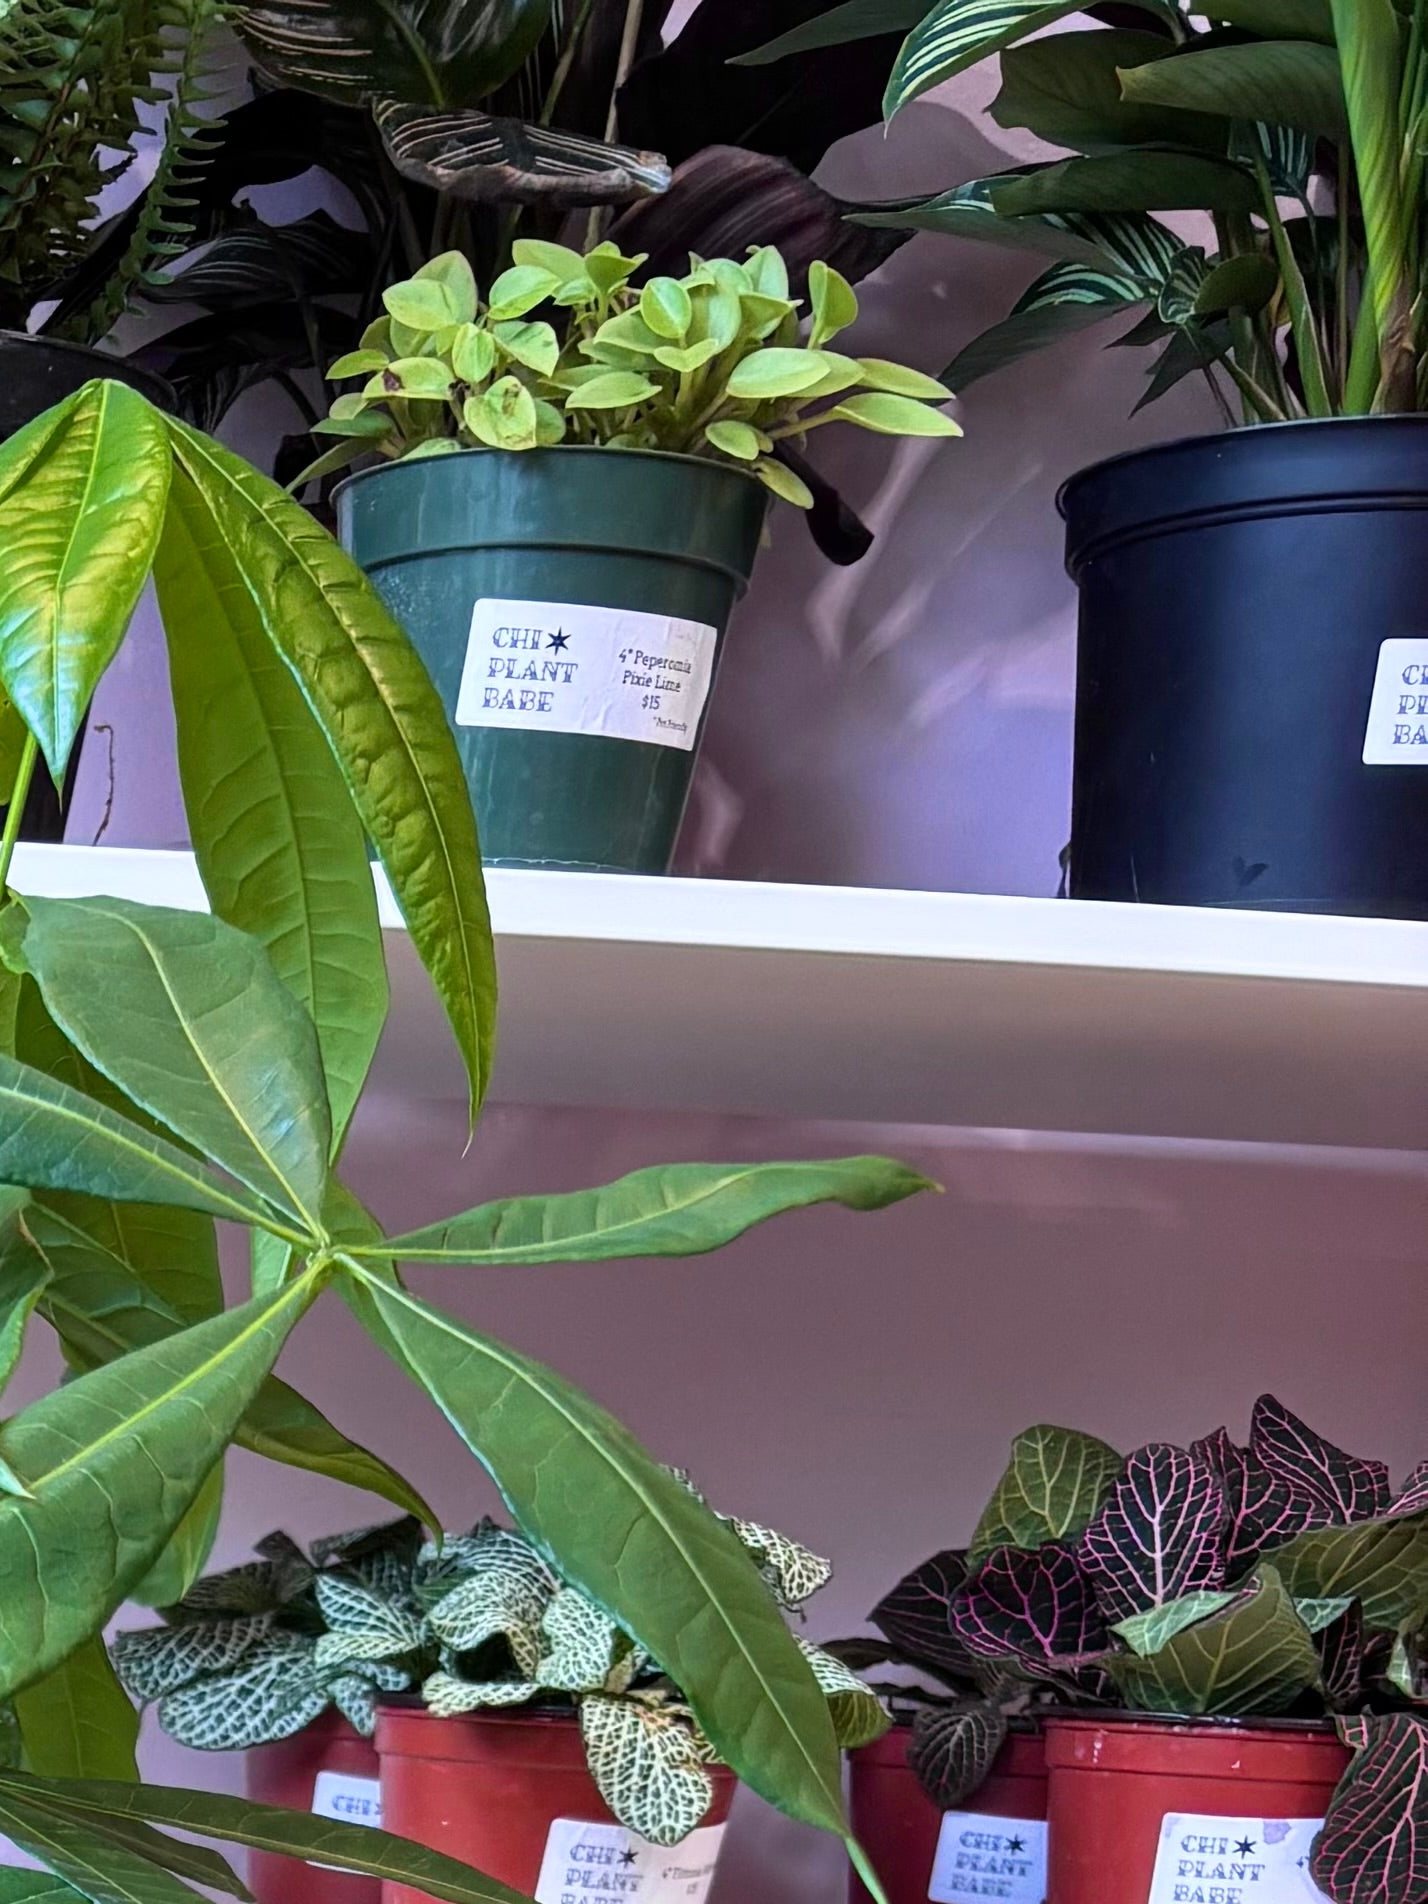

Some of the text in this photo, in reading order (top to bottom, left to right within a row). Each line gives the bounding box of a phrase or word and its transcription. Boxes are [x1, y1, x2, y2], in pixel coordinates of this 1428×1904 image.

[492, 627, 542, 650] CHI
[487, 657, 578, 684] PLANT
[481, 687, 554, 713] BABE
[641, 694, 662, 710] $15
[959, 1830, 1003, 1851] CHI
[1180, 1835, 1228, 1855] CHI
[570, 1844, 618, 1865] CHI
[955, 1852, 1033, 1877] PLANT
[564, 1868, 644, 1893] PLANT
[1177, 1859, 1266, 1882] PLANT
[1172, 1884, 1243, 1904] BABE
